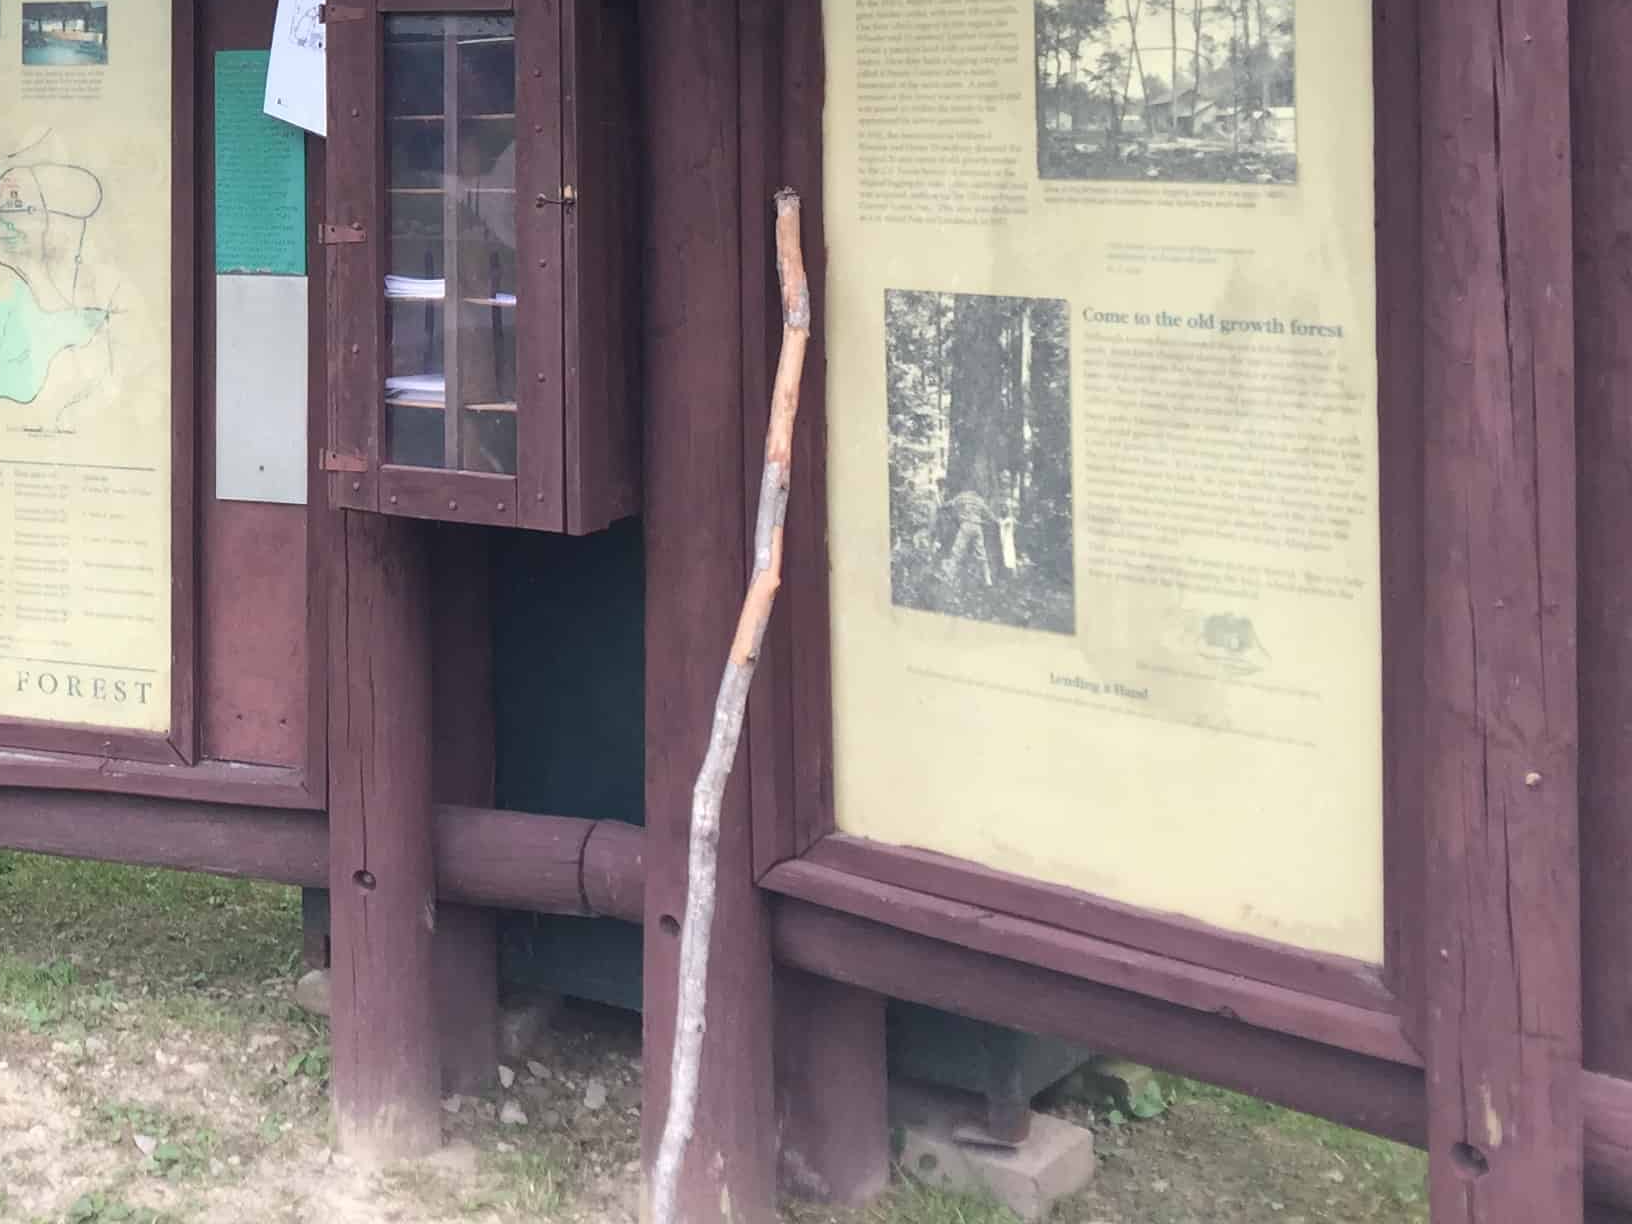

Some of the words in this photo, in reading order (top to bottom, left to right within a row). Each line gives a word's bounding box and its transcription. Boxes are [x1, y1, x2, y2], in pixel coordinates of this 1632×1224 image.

[1083, 308, 1130, 325] Come
[1135, 311, 1150, 326] to
[1156, 311, 1182, 328] the
[1187, 314, 1214, 330] old
[1220, 317, 1284, 334] growth
[1290, 320, 1344, 338] forest
[16, 670, 154, 704] FOREST
[1050, 672, 1100, 694] Lending
[1115, 681, 1149, 700] Hand
